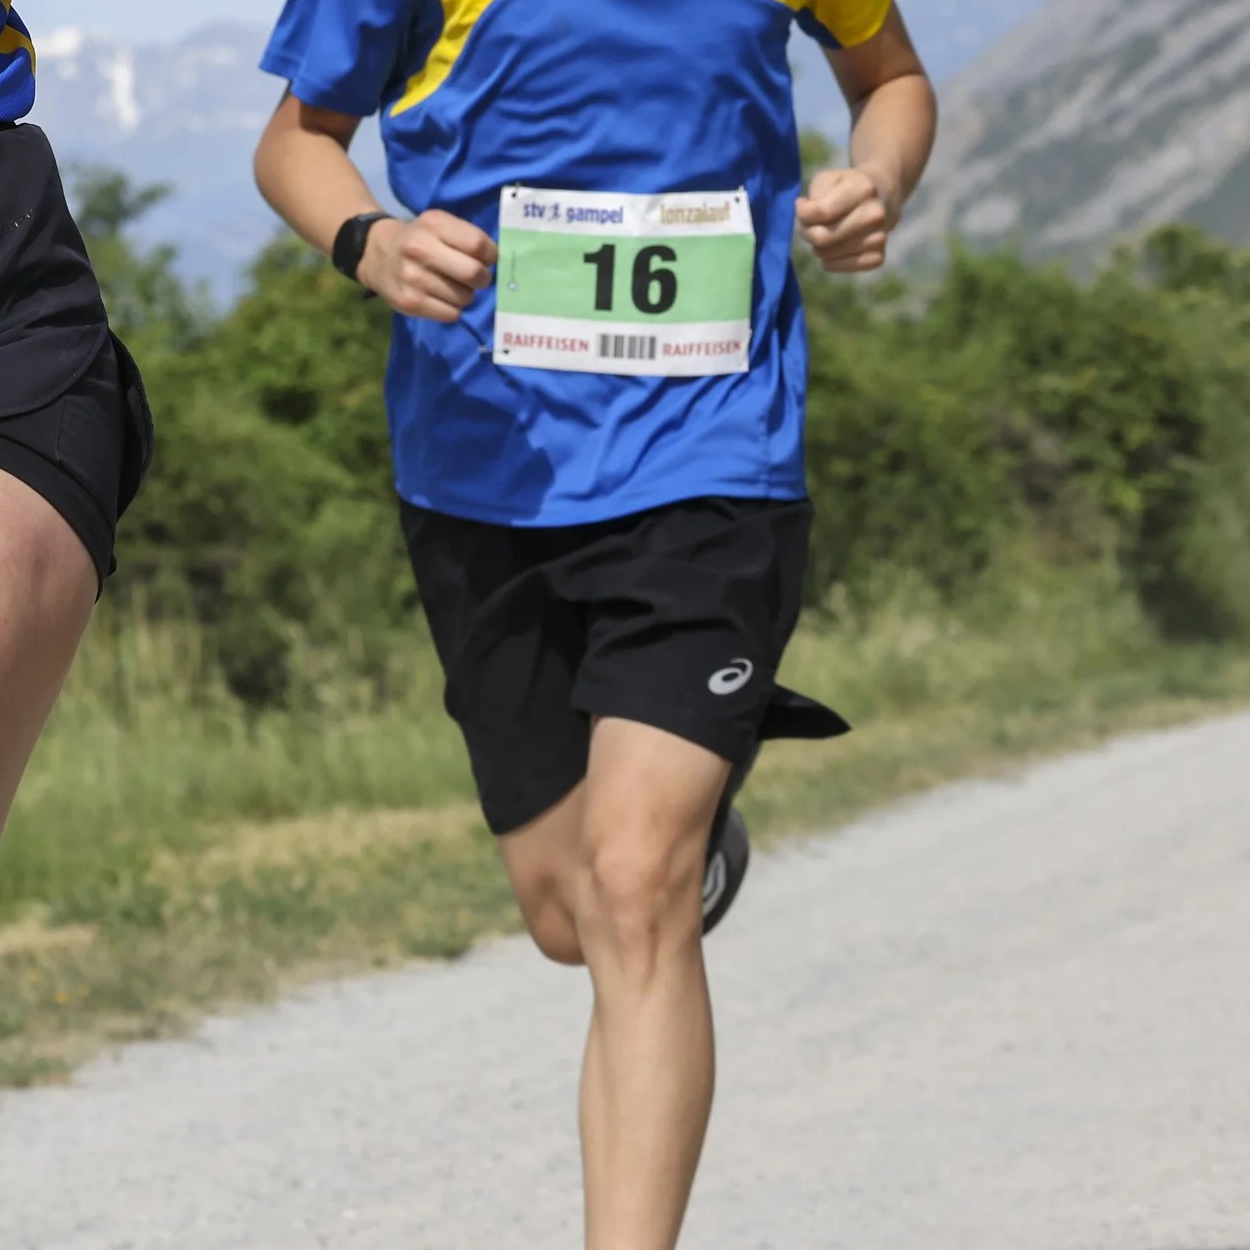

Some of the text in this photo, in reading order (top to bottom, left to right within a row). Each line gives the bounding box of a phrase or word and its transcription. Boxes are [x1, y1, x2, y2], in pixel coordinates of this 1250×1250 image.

[523, 202, 624, 224] stv gampel
[583, 244, 678, 315] 16
[503, 332, 589, 352] RAIFFEISEN
[662, 340, 742, 357] RAIFFEISEN
